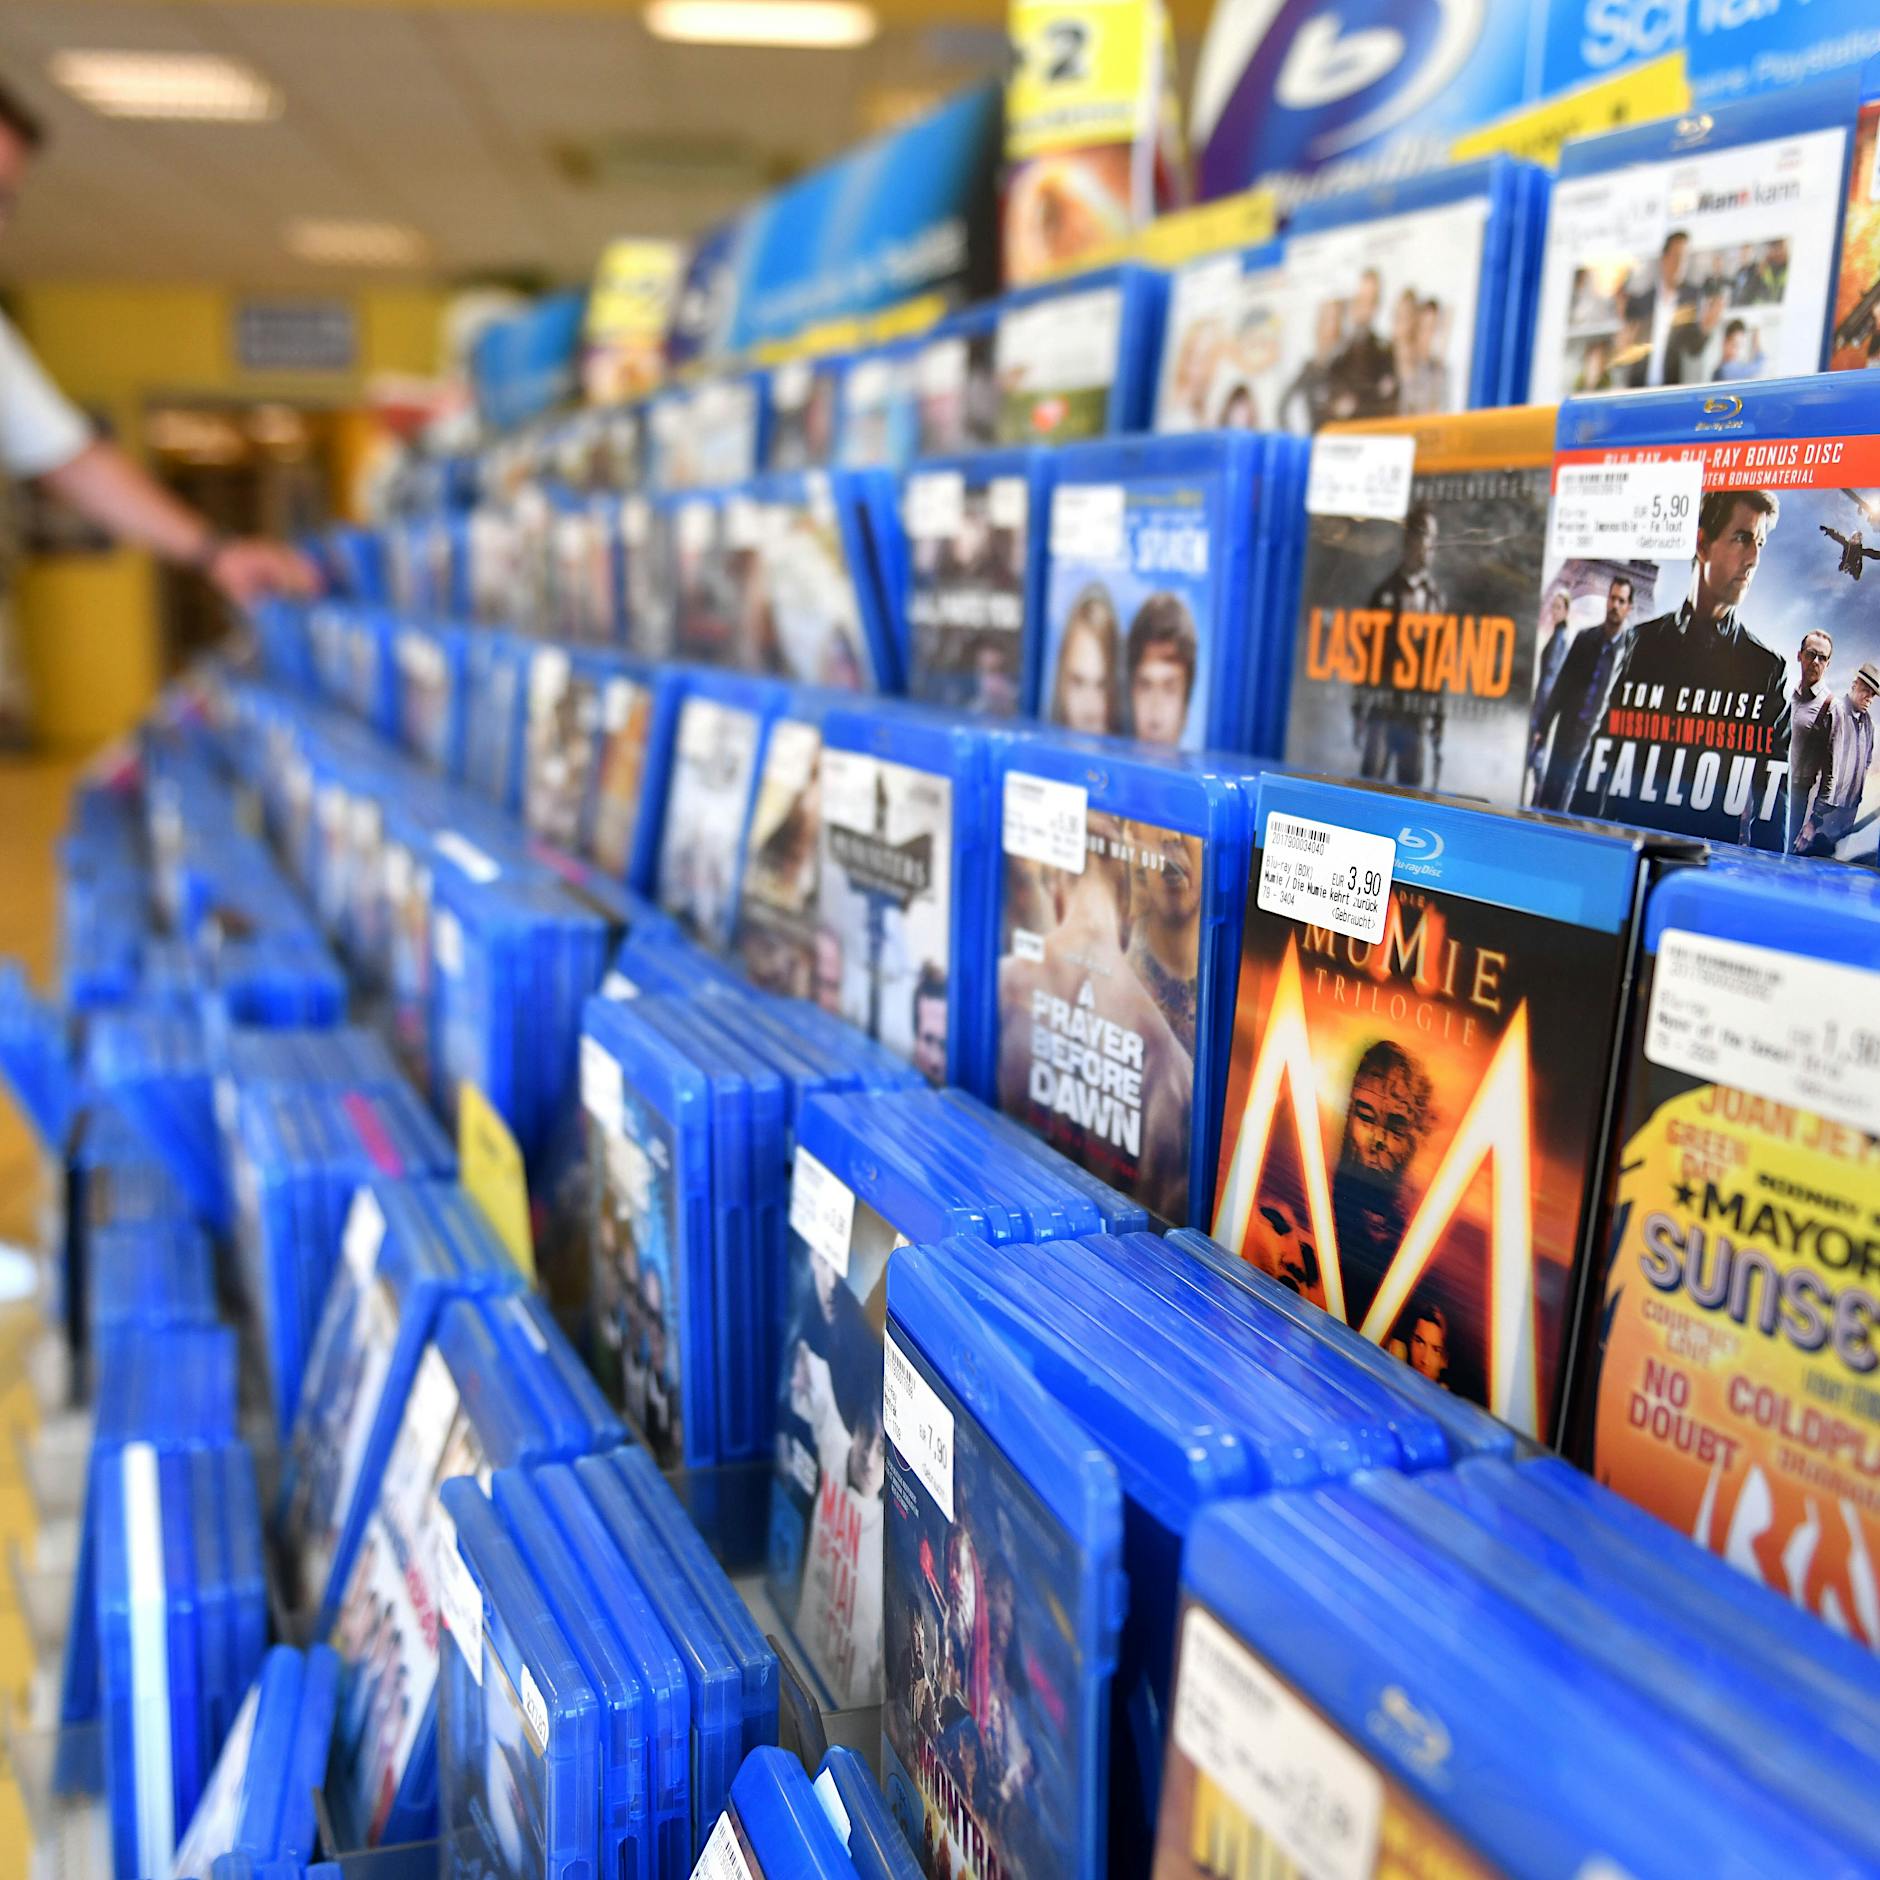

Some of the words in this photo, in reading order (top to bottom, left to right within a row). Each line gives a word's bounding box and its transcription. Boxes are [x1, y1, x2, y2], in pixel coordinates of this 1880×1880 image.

[1680, 446, 1741, 467] BLU-RAY
[1746, 445, 1797, 467] BONUS
[1804, 443, 1843, 465] DISC
[1729, 468, 1815, 487] BONUSMATERIAL
[1652, 495, 1689, 520] 5,90
[1306, 607, 1394, 687] LAST
[1393, 612, 1515, 699] STAND
[1622, 682, 1664, 709] TOM
[1676, 687, 1764, 720] CRUISE
[1585, 738, 1789, 821] FALLOUT
[1110, 841, 1136, 863] WAY
[1141, 851, 1166, 872] OUT
[1272, 832, 1325, 856] 2017900034040
[1266, 856, 1292, 873] Blu-ray
[1294, 864, 1314, 879] (BOX)
[1332, 872, 1345, 888] EUR
[1347, 866, 1382, 897] 3,90
[1394, 858, 1422, 877] lu-ray
[1421, 864, 1443, 878] Disc
[1264, 870, 1283, 887] Mumie
[1292, 877, 1305, 891] Die
[1306, 881, 1327, 899] Mumie
[1329, 886, 1351, 906] kehrt
[1352, 895, 1379, 914] zurück
[1279, 891, 1295, 906] 3404
[1400, 889, 1425, 908] DIE
[1331, 908, 1376, 930] <Gebraucht>
[1301, 892, 1506, 1015] MUMIE
[1078, 979, 1097, 1009] A
[1315, 967, 1476, 1046] TRILOGIE
[1032, 988, 1144, 1072] PRAYER
[1031, 1024, 1143, 1111] BEFORE
[1029, 1059, 1141, 1158] DAWN
[1699, 1083, 1798, 1139] JOAN
[1645, 1358, 1690, 1409] NO
[927, 1424, 948, 1470] 7,90
[1629, 1391, 1738, 1471] DOUBT
